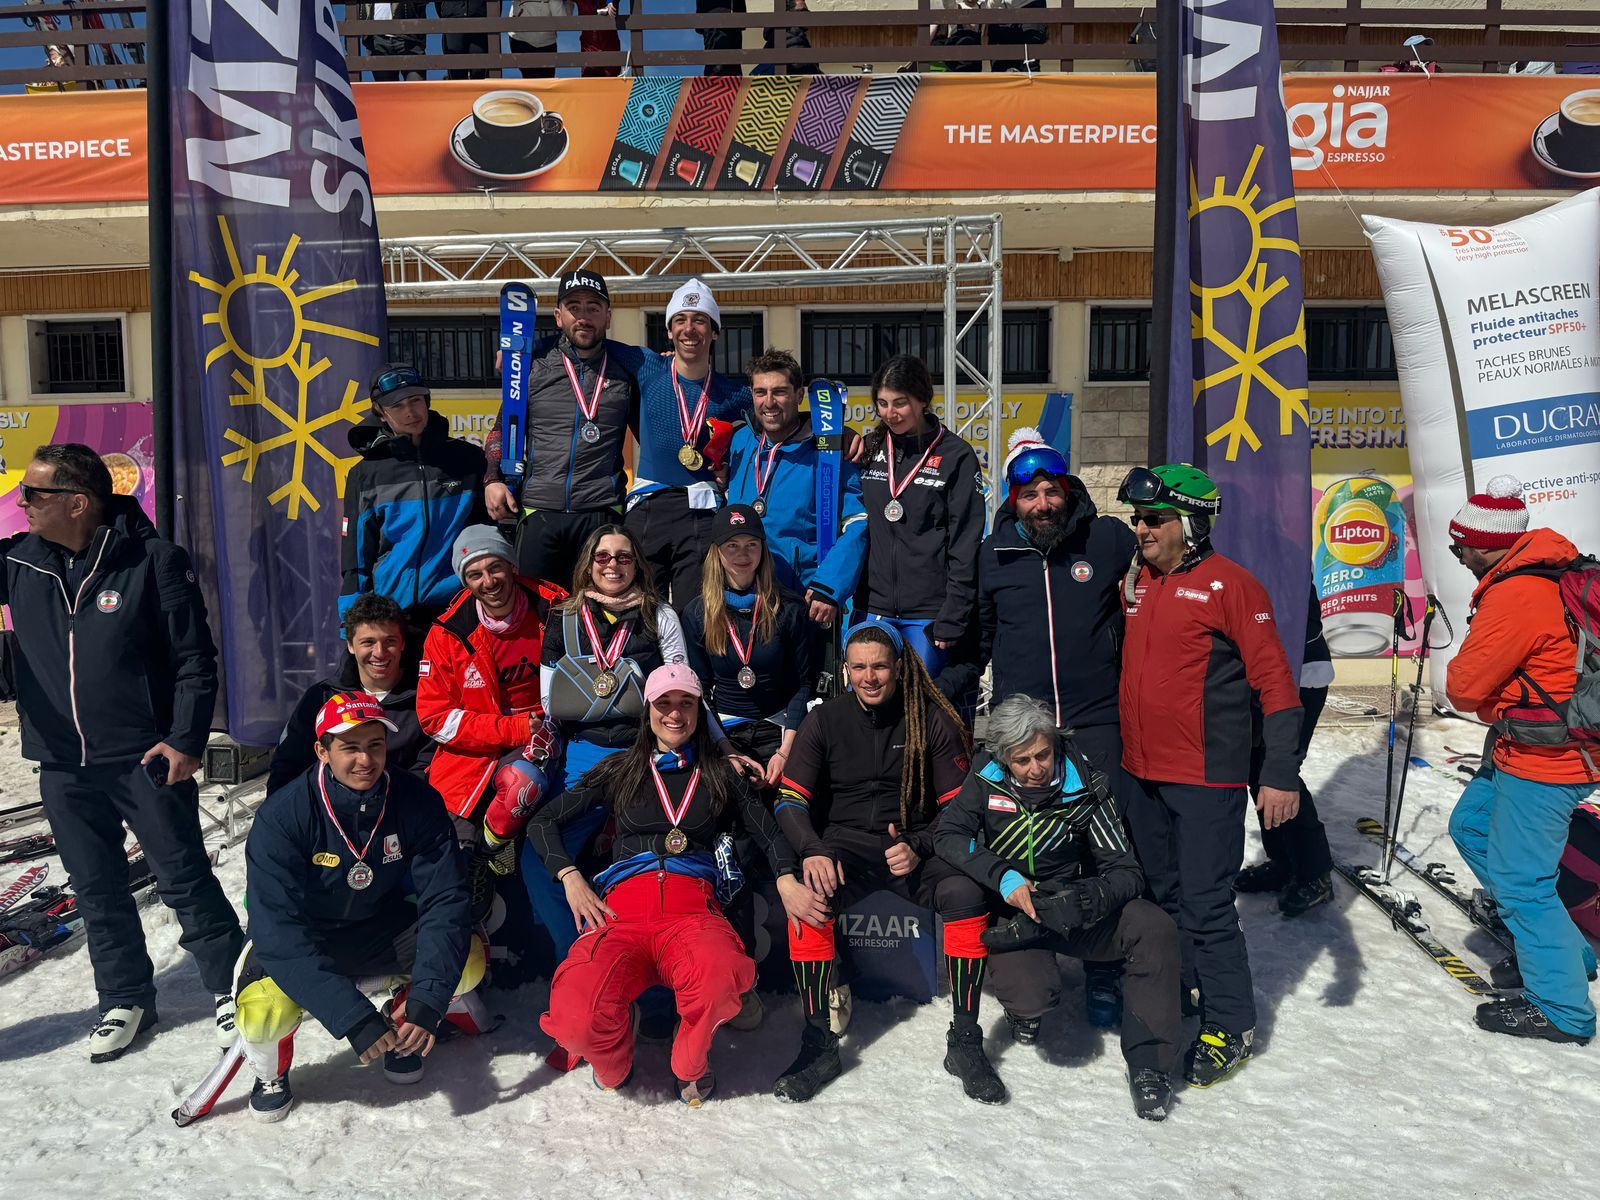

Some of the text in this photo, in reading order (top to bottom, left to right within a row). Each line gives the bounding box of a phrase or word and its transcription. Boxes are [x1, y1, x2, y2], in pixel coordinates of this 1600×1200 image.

[1347, 86, 1390, 98] NAJJAR
[944, 125, 1157, 144] THE MASTERPIEC
[1327, 152, 1385, 163] ESPRESSO
[565, 273, 601, 290] PARIS
[1467, 283, 1590, 315] MELASCREEN
[1471, 309, 1579, 333] Fluide antitaches
[1472, 321, 1587, 350] protecteur SPF50+
[1476, 346, 1571, 370] TACHES BRUNES
[1478, 366, 1521, 383] PEAUX
[1524, 357, 1582, 375] NORMALES
[1310, 407, 1334, 424] DE
[1338, 407, 1386, 425] INTO
[1496, 435, 1553, 450] LABORATOIRES
[1529, 489, 1578, 504] SPF50+
[1335, 526, 1380, 540] Lipton
[1323, 567, 1363, 587] ZERO
[1184, 591, 1208, 601] Sunrise
[1322, 582, 1354, 597] SUGAR
[1321, 593, 1378, 611] RED FRUITS
[849, 938, 900, 948] SKI RESORT
